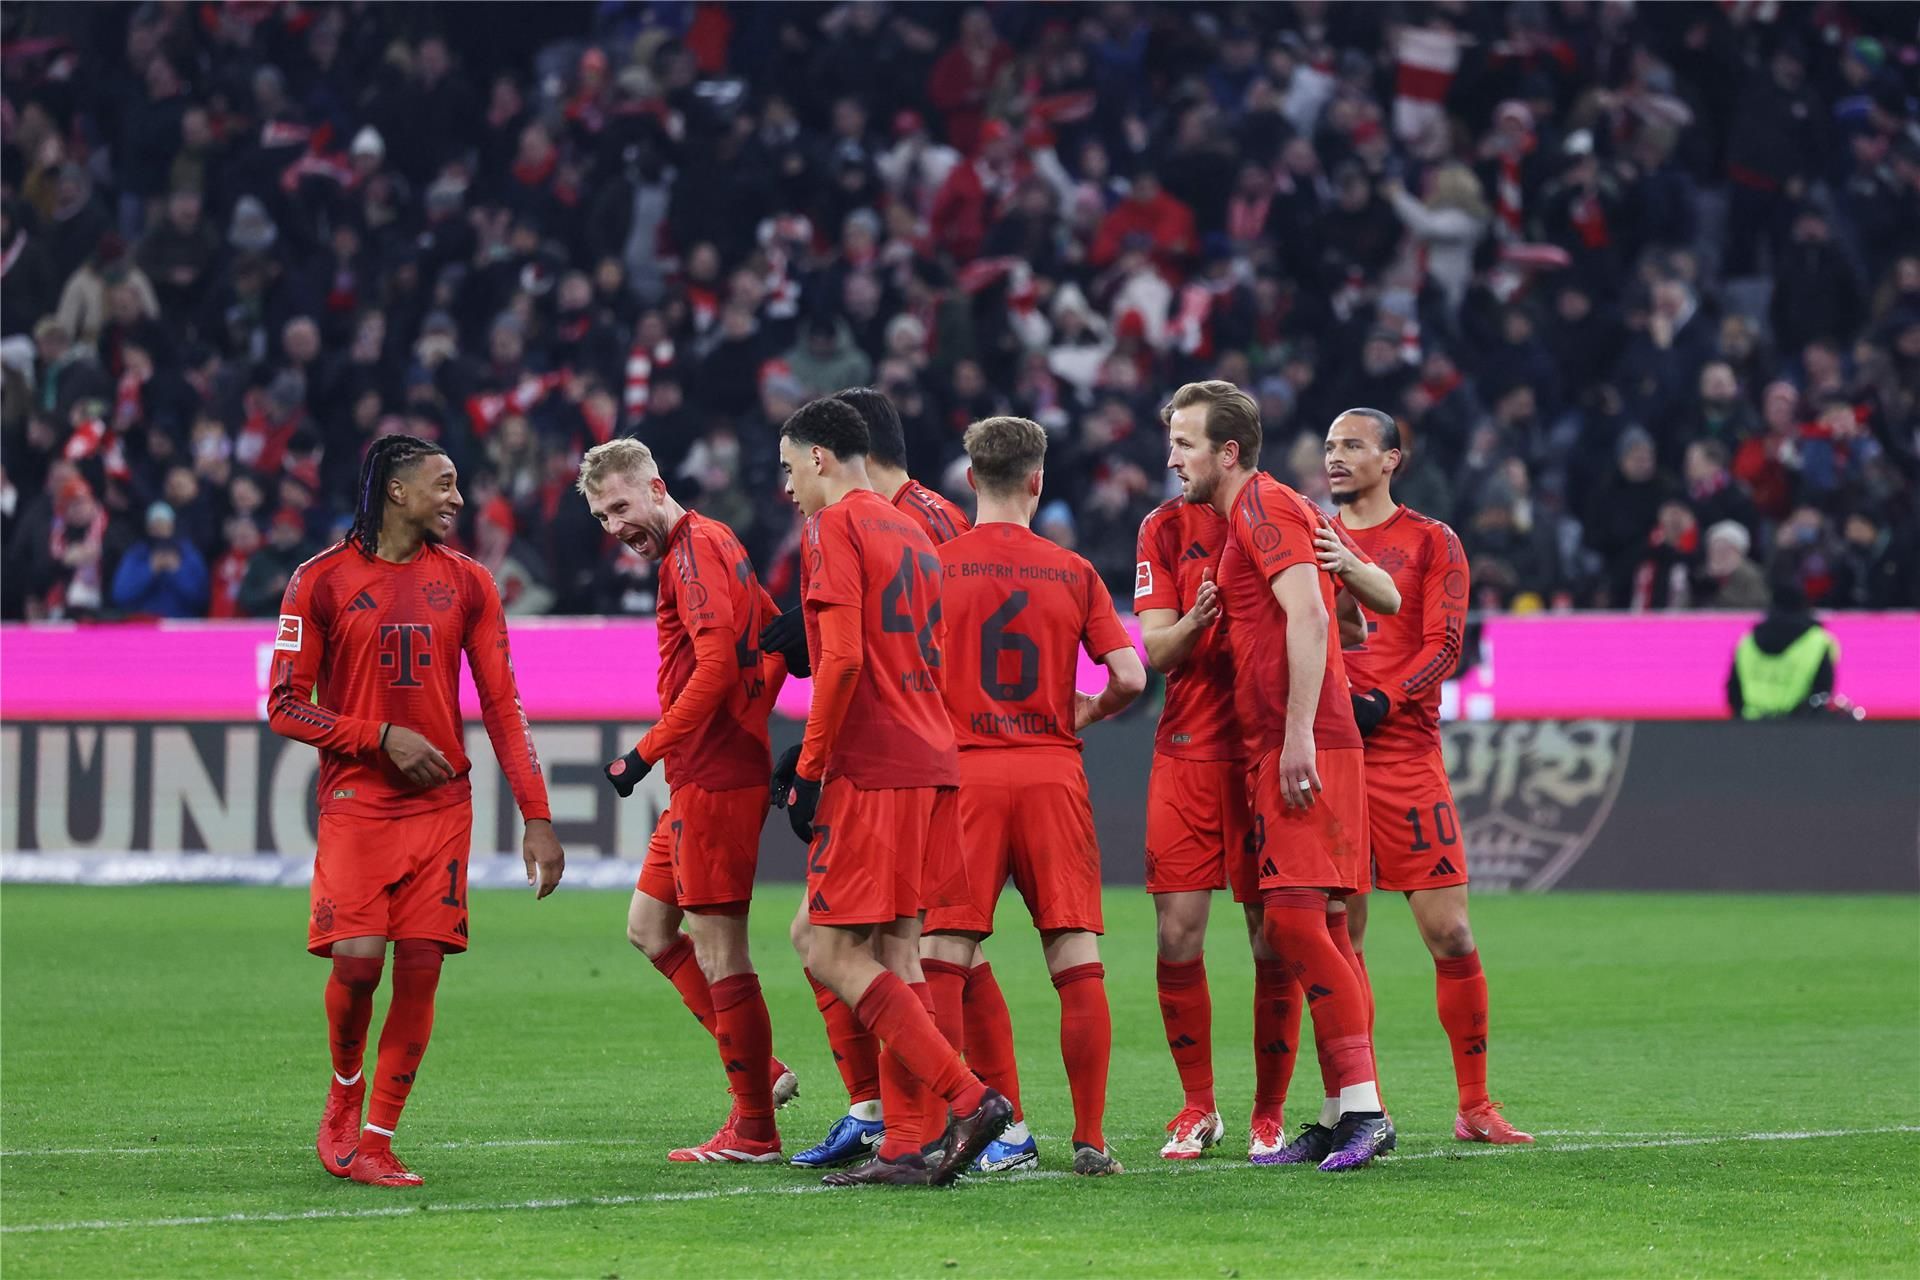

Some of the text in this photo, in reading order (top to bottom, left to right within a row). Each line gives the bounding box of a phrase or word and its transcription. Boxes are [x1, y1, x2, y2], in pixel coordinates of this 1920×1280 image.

[962, 563, 1013, 577] BAYERN
[1020, 566, 1078, 584] MÜNCHEN
[882, 547, 942, 668] 42
[981, 590, 1040, 702] 6
[970, 712, 1058, 735] KIMMICH
[1405, 802, 1457, 852] 10
[441, 859, 467, 909] 1
